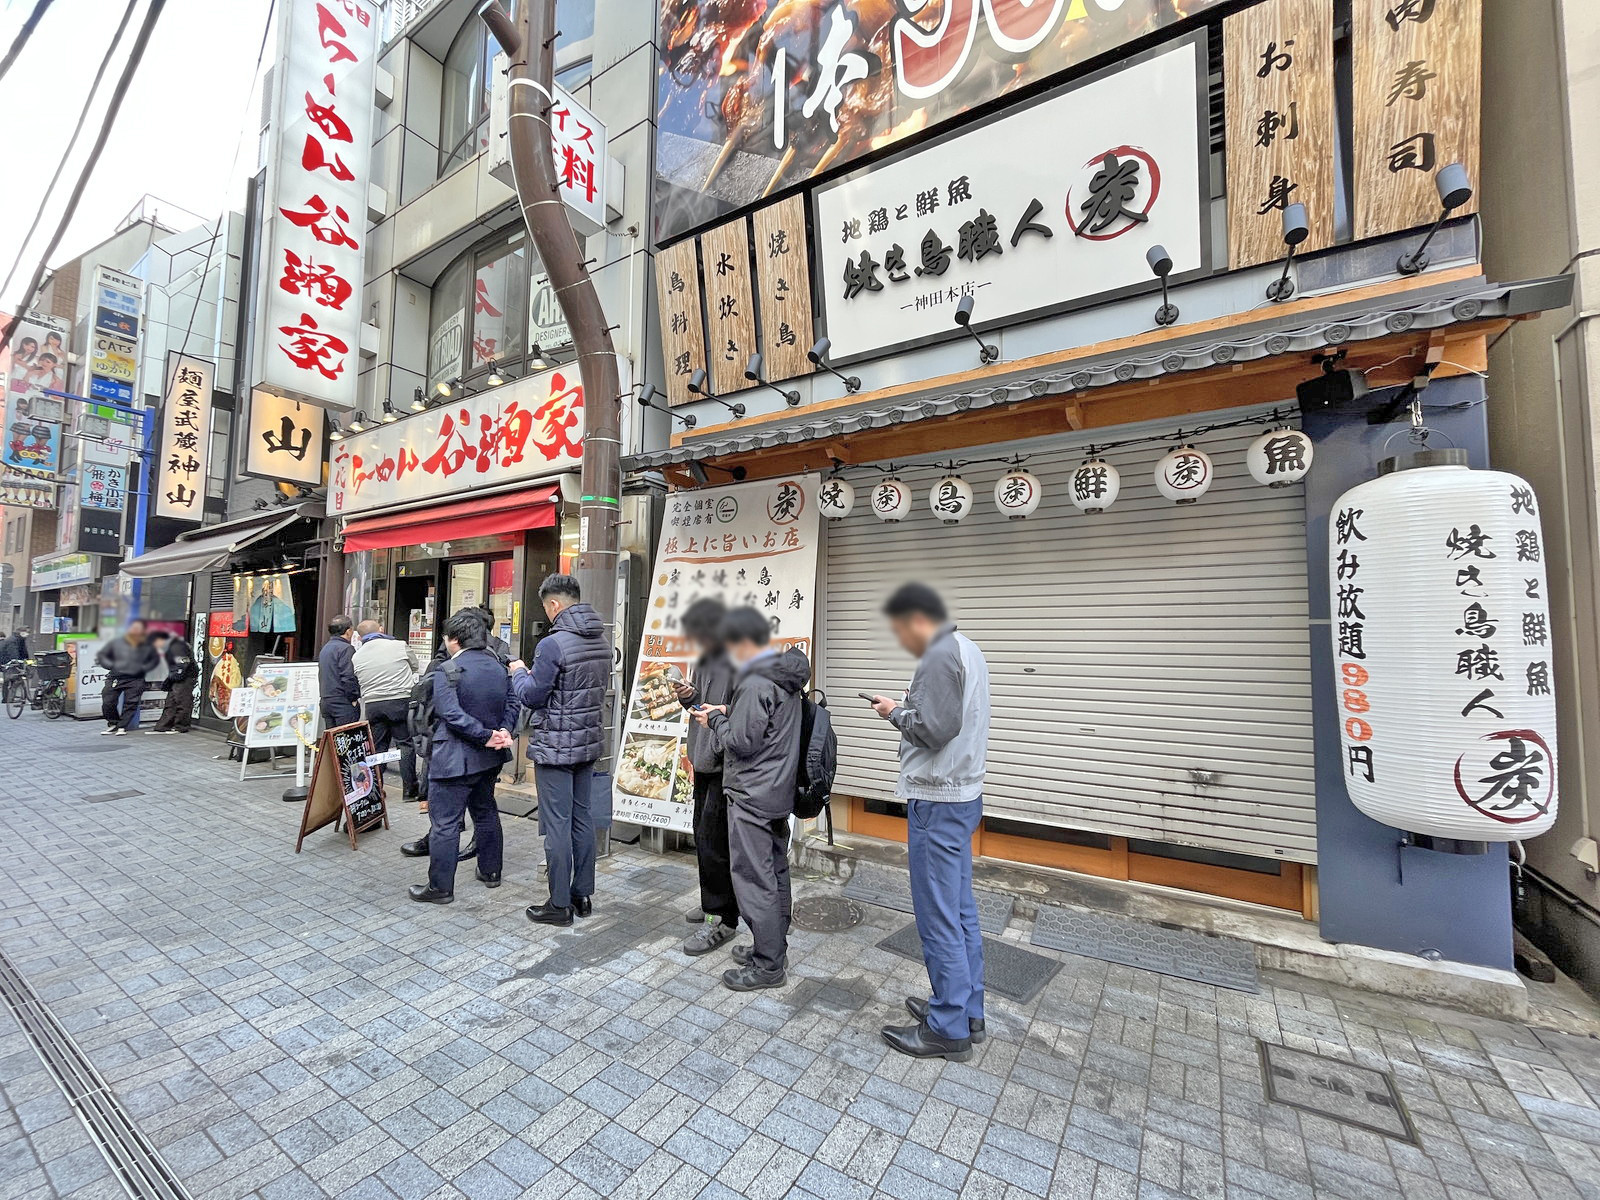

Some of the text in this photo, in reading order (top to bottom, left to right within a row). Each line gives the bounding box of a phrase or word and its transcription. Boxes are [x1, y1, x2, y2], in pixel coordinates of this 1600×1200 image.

[552, 106, 595, 155] イス
[1254, 40, 1299, 215] お刺身
[842, 175, 973, 243] 地鶏と鮮魚
[1075, 153, 1149, 237] 炭
[842, 198, 1053, 300] 焼き鳥職人
[716, 252, 739, 361] 水炊き
[768, 230, 796, 348] 焼き鳥
[535, 327, 571, 342] DESIGNER
[668, 271, 692, 376] 鳥料理
[97, 339, 134, 354] CATS
[92, 384, 116, 394] スナック
[96, 362, 131, 377] ゆかり
[262, 416, 312, 461] 山
[1266, 435, 1306, 475] 魚
[105, 469, 121, 508] かき小屋
[1003, 478, 1026, 506] 炭
[1074, 467, 1108, 500] 鮮
[1171, 456, 1200, 489] 炭
[671, 498, 715, 514] 完全個室
[770, 484, 799, 521] 炭
[818, 481, 845, 510] 焼
[876, 485, 897, 512] 炭
[934, 482, 966, 513] 鳥
[664, 527, 800, 555] 極上に旨いお店
[1511, 485, 1551, 696] 地鶏と鮮魚
[1446, 524, 1505, 720] 焼き鳥職人
[1472, 737, 1549, 815] 炭
